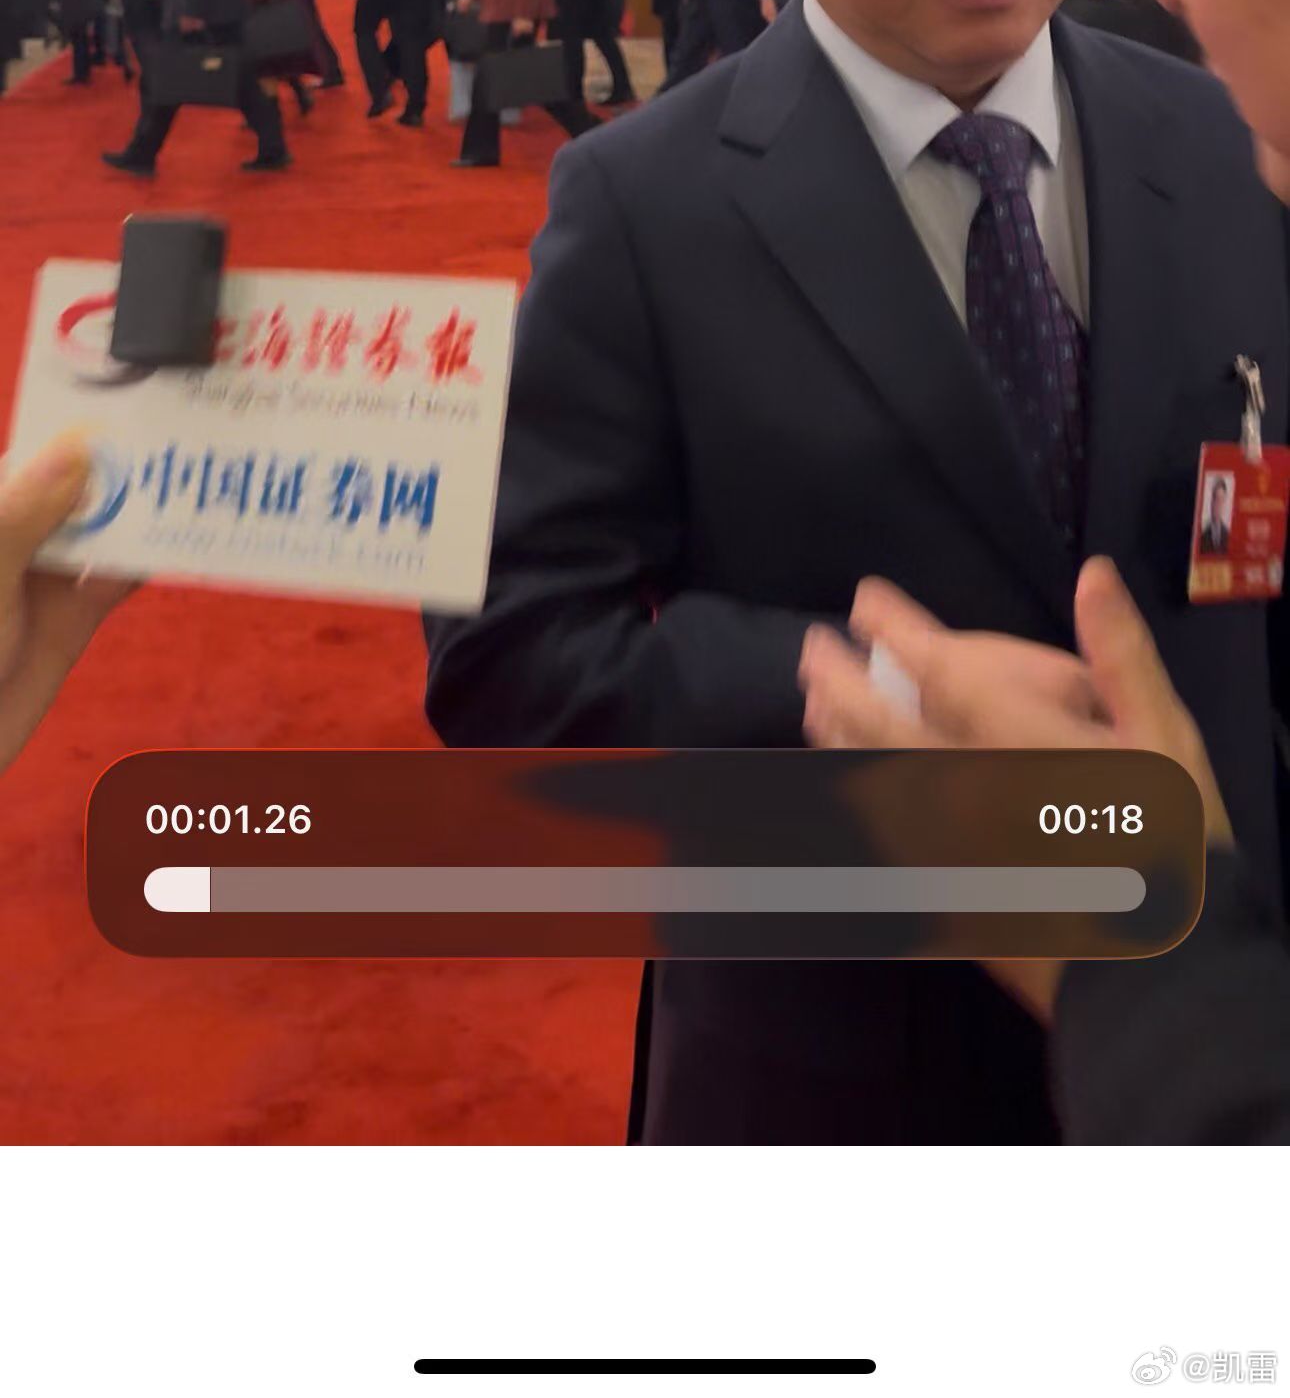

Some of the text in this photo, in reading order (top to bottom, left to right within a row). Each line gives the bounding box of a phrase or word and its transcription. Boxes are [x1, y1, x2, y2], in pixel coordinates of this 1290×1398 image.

[141, 442, 441, 534] 中国证券网
